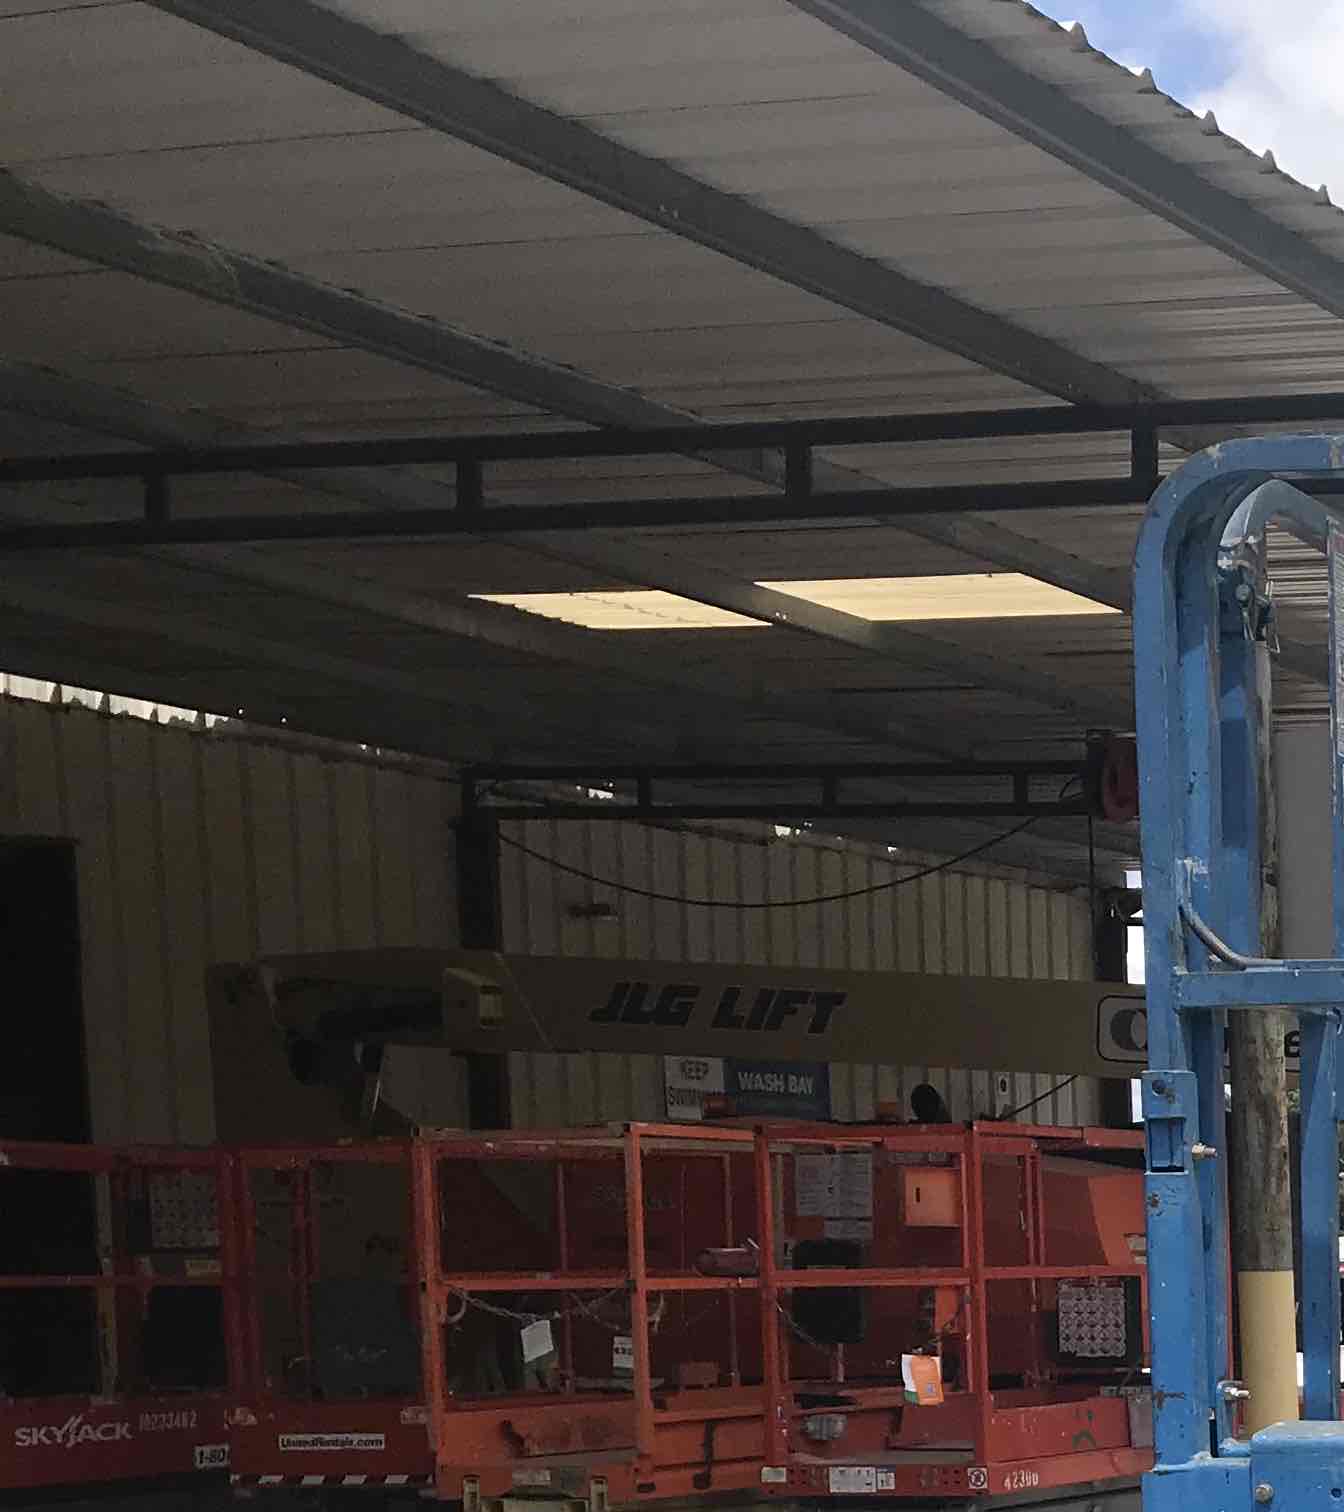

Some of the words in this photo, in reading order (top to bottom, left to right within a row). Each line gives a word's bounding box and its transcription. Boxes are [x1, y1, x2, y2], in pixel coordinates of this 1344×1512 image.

[589, 981, 697, 1026] JLG
[711, 991, 848, 1034] LIFT
[737, 1071, 784, 1095] WASH
[787, 1073, 815, 1095] BAY
[15, 1415, 133, 1448] SKYJACK
